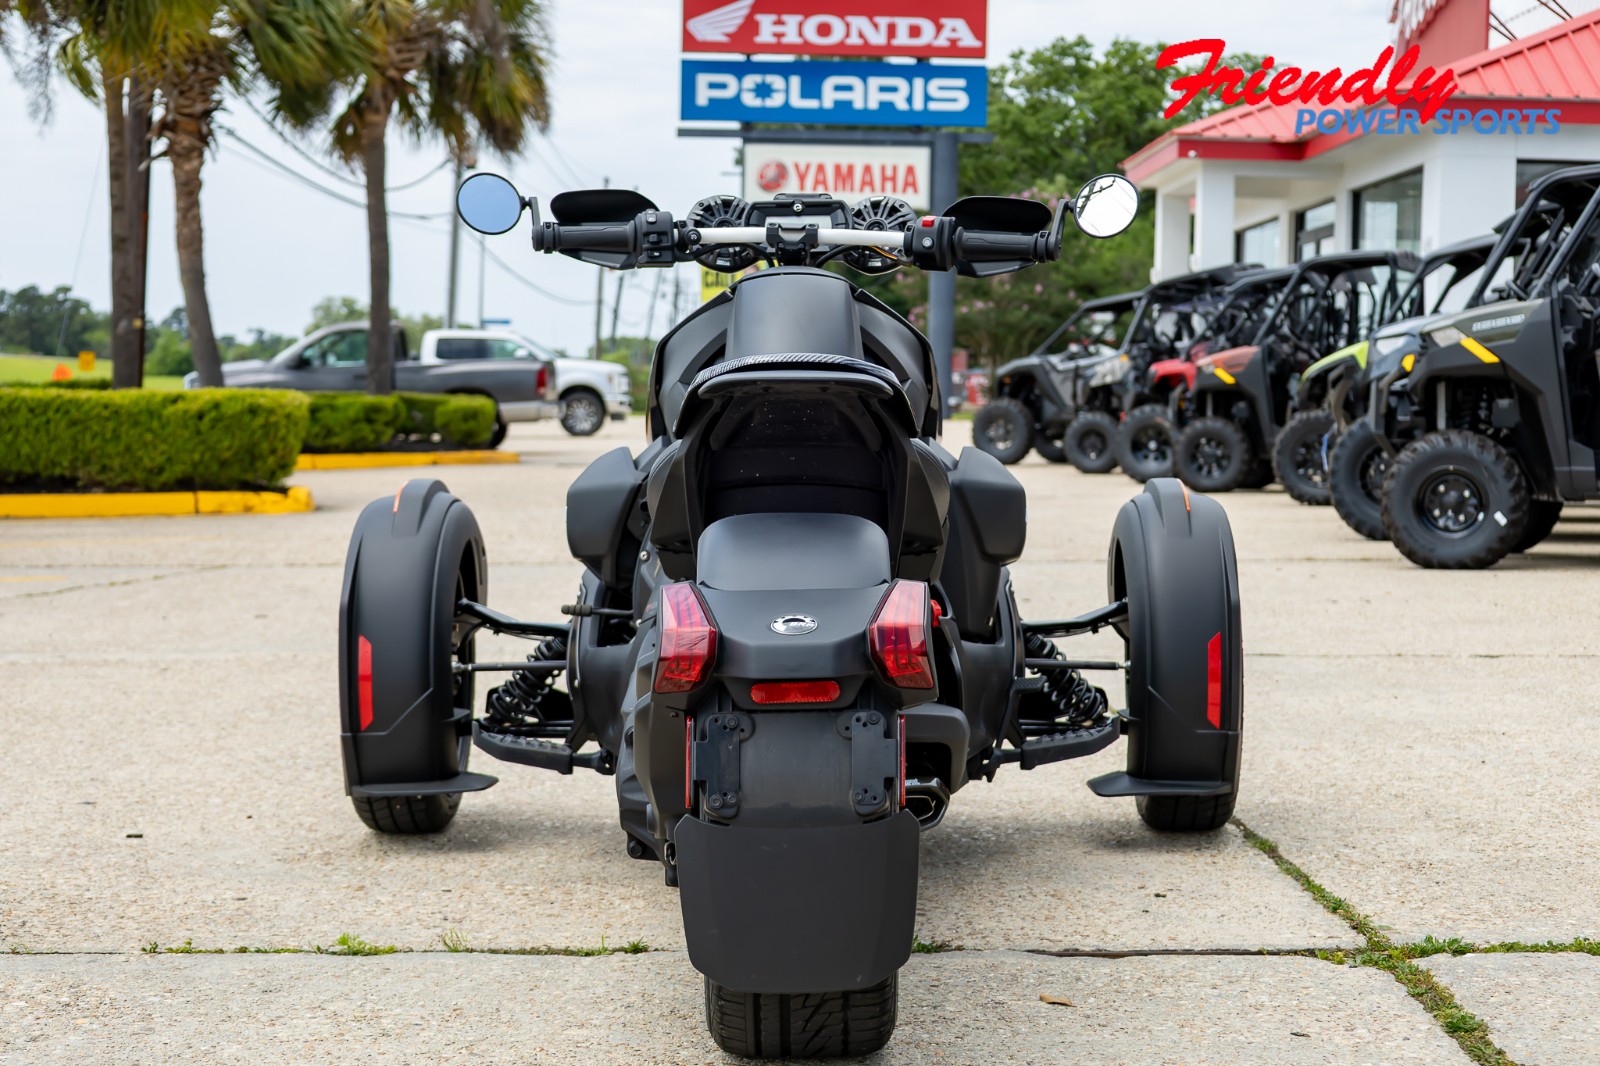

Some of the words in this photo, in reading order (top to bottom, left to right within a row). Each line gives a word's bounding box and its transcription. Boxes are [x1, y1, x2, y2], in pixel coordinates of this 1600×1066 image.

[753, 14, 983, 49] HONDA
[695, 72, 970, 112] POLARIS
[793, 162, 919, 194] YAMAHA
